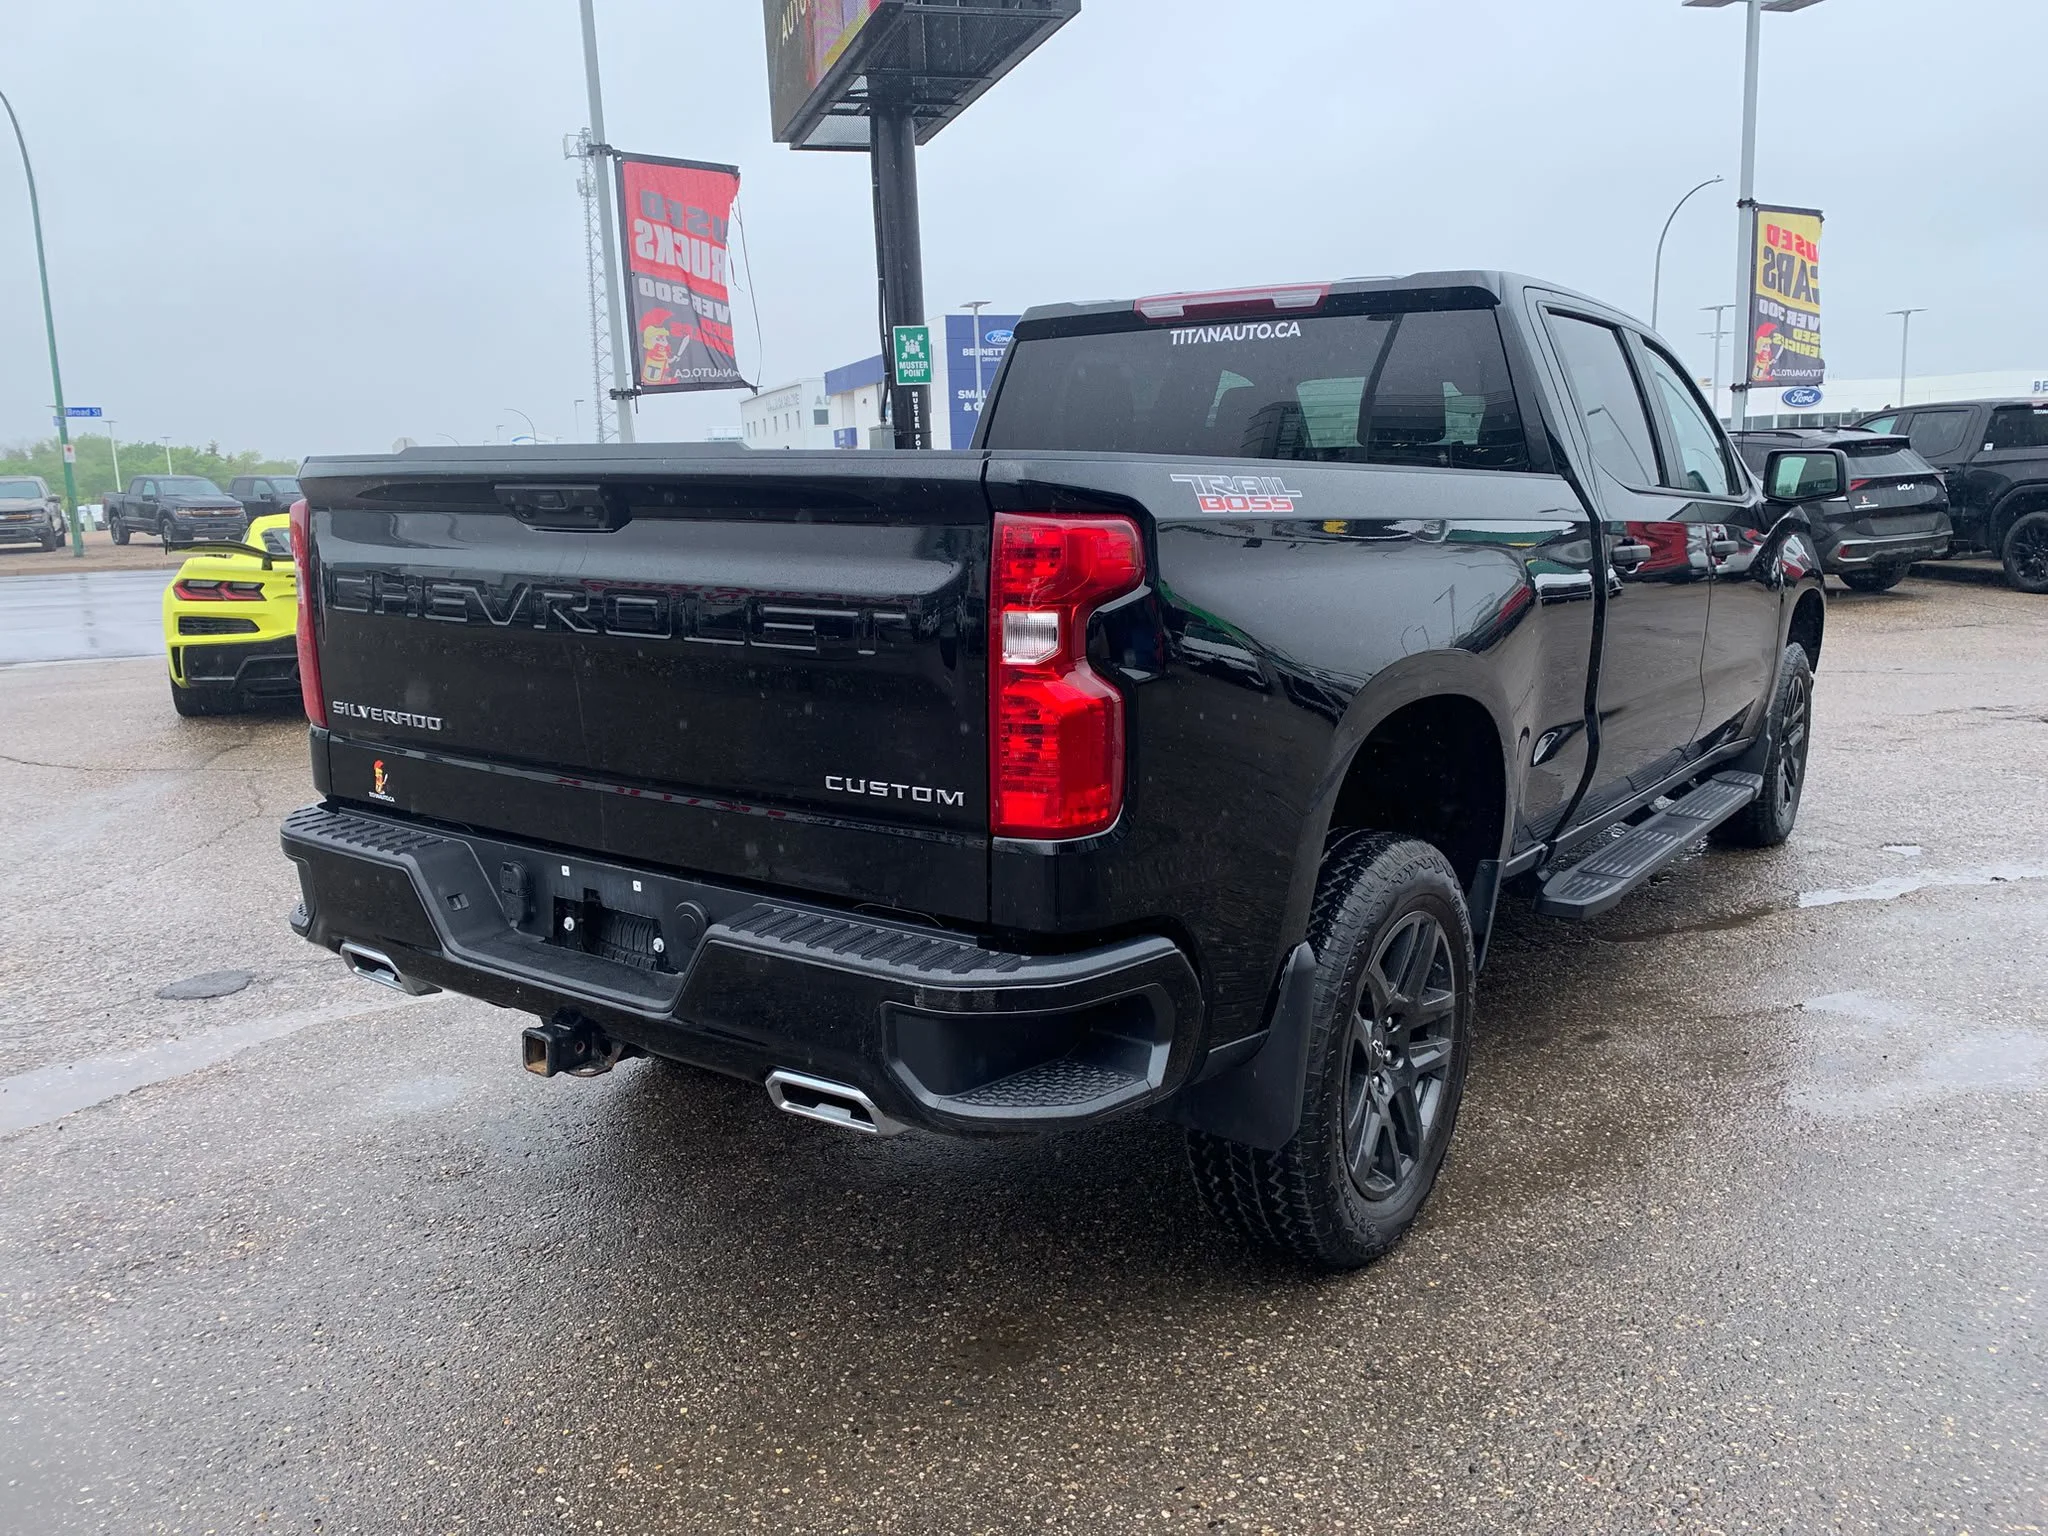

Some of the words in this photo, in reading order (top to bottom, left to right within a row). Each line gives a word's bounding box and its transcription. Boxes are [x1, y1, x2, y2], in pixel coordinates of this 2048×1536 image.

[1170, 321, 1302, 345] TITANAUTO.CA
[962, 348, 1006, 356] BENETT
[899, 361, 929, 370] MUSTER
[903, 369, 926, 377] POINT
[67, 408, 90, 416] Broad
[911, 391, 921, 429] MUSTER
[1170, 473, 1303, 497] TRAIL
[1197, 495, 1295, 513] BOSS
[331, 570, 912, 656] CHEVROLET
[332, 700, 444, 731] SILVERADO
[825, 775, 965, 807] CUSTOM
